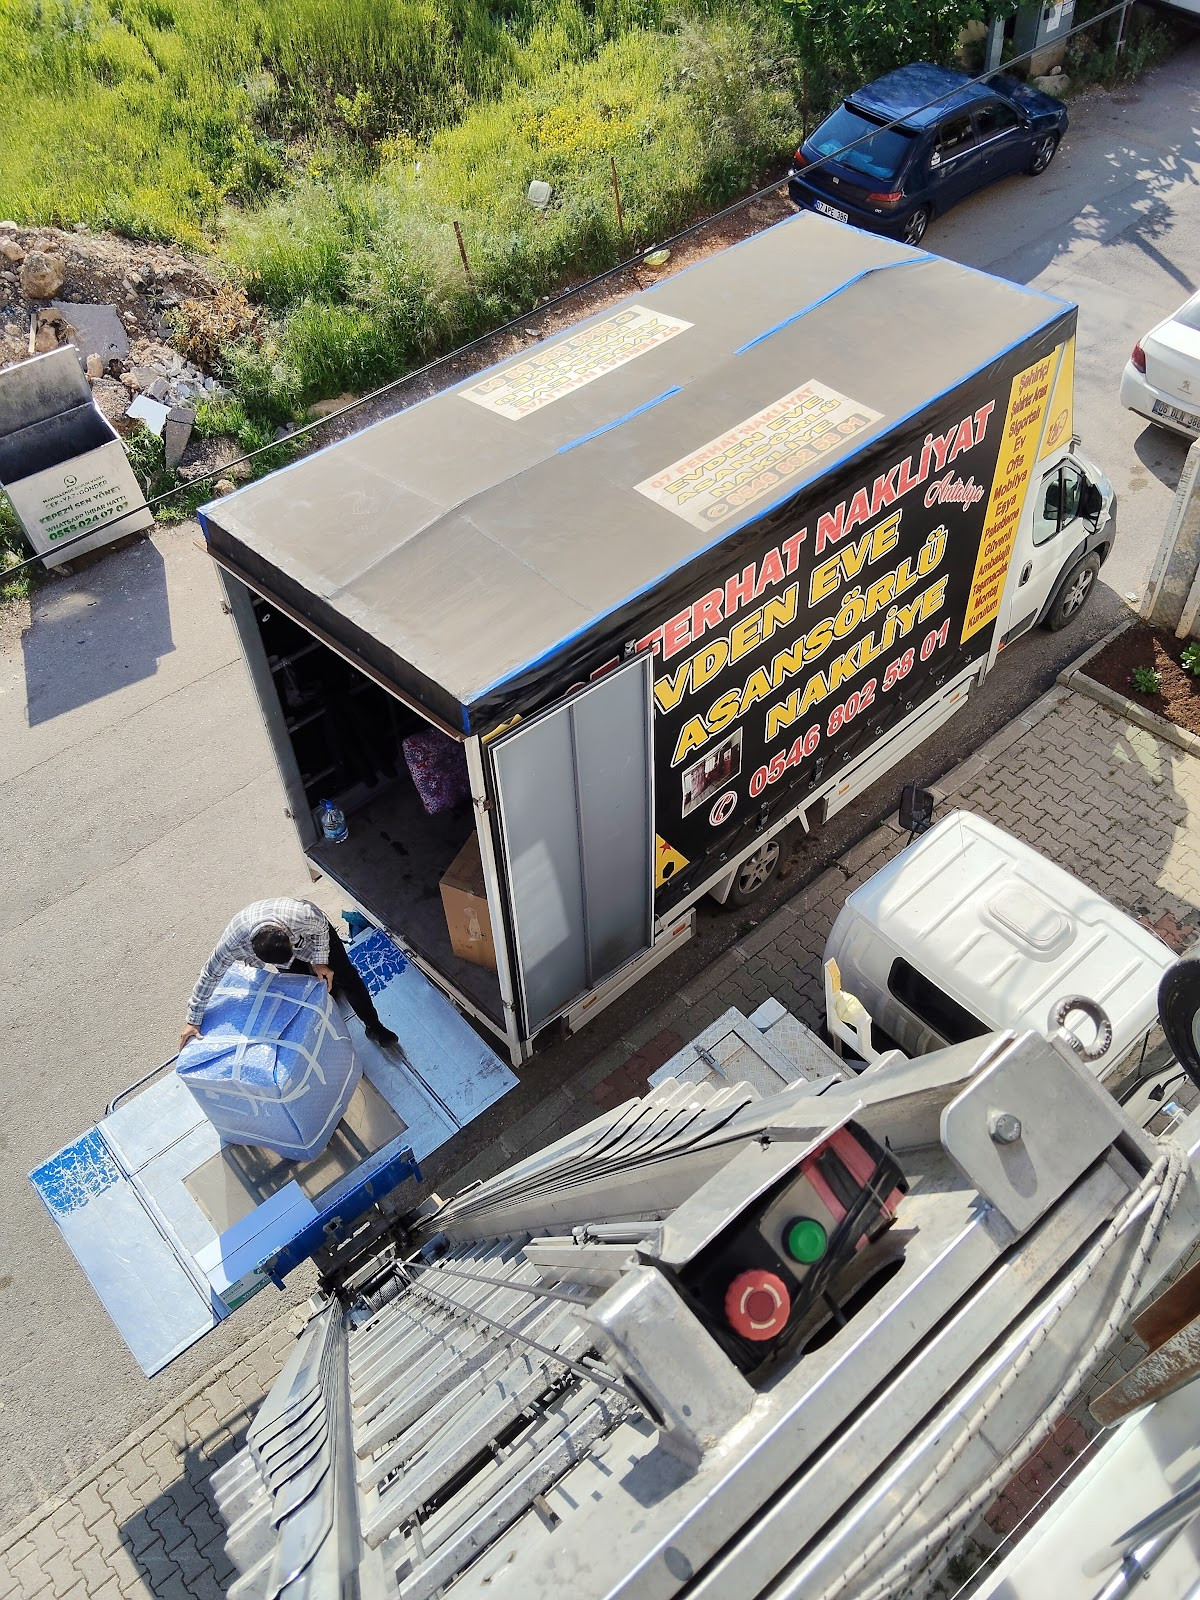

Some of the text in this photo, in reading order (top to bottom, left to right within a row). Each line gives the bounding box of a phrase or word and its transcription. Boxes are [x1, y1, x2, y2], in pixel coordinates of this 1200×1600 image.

[510, 324, 669, 408] EVDEN EVE
[599, 338, 660, 371] FERHAT
[479, 378, 506, 392] 01
[651, 387, 815, 489] 07 FERHAT NAKLİYAT
[664, 395, 824, 494] EVDEN EVE
[677, 399, 841, 505] ASANSÖRLÜ
[1013, 435, 1026, 453] Ev
[709, 420, 834, 498] NAKLİYE
[726, 416, 866, 506] 0546 802 58 01
[815, 399, 995, 555] NAKLİYAT
[74, 497, 92, 509] SEN
[924, 470, 985, 511] Antalya
[993, 469, 1028, 502] Mobilya
[45, 513, 83, 533] WHATSAPP
[49, 524, 78, 541] 0555
[78, 514, 99, 527] 024
[101, 507, 113, 518] 07
[983, 507, 1019, 542] Paketleme
[984, 526, 1013, 557] Güvenli
[808, 508, 903, 608] EVE
[967, 598, 999, 630] Kurulum
[973, 581, 999, 610] Montaj
[670, 524, 949, 767] ASANSÖRLÜ
[764, 574, 949, 742] NAKLİYE
[749, 617, 950, 798] 0546 802 58 01
